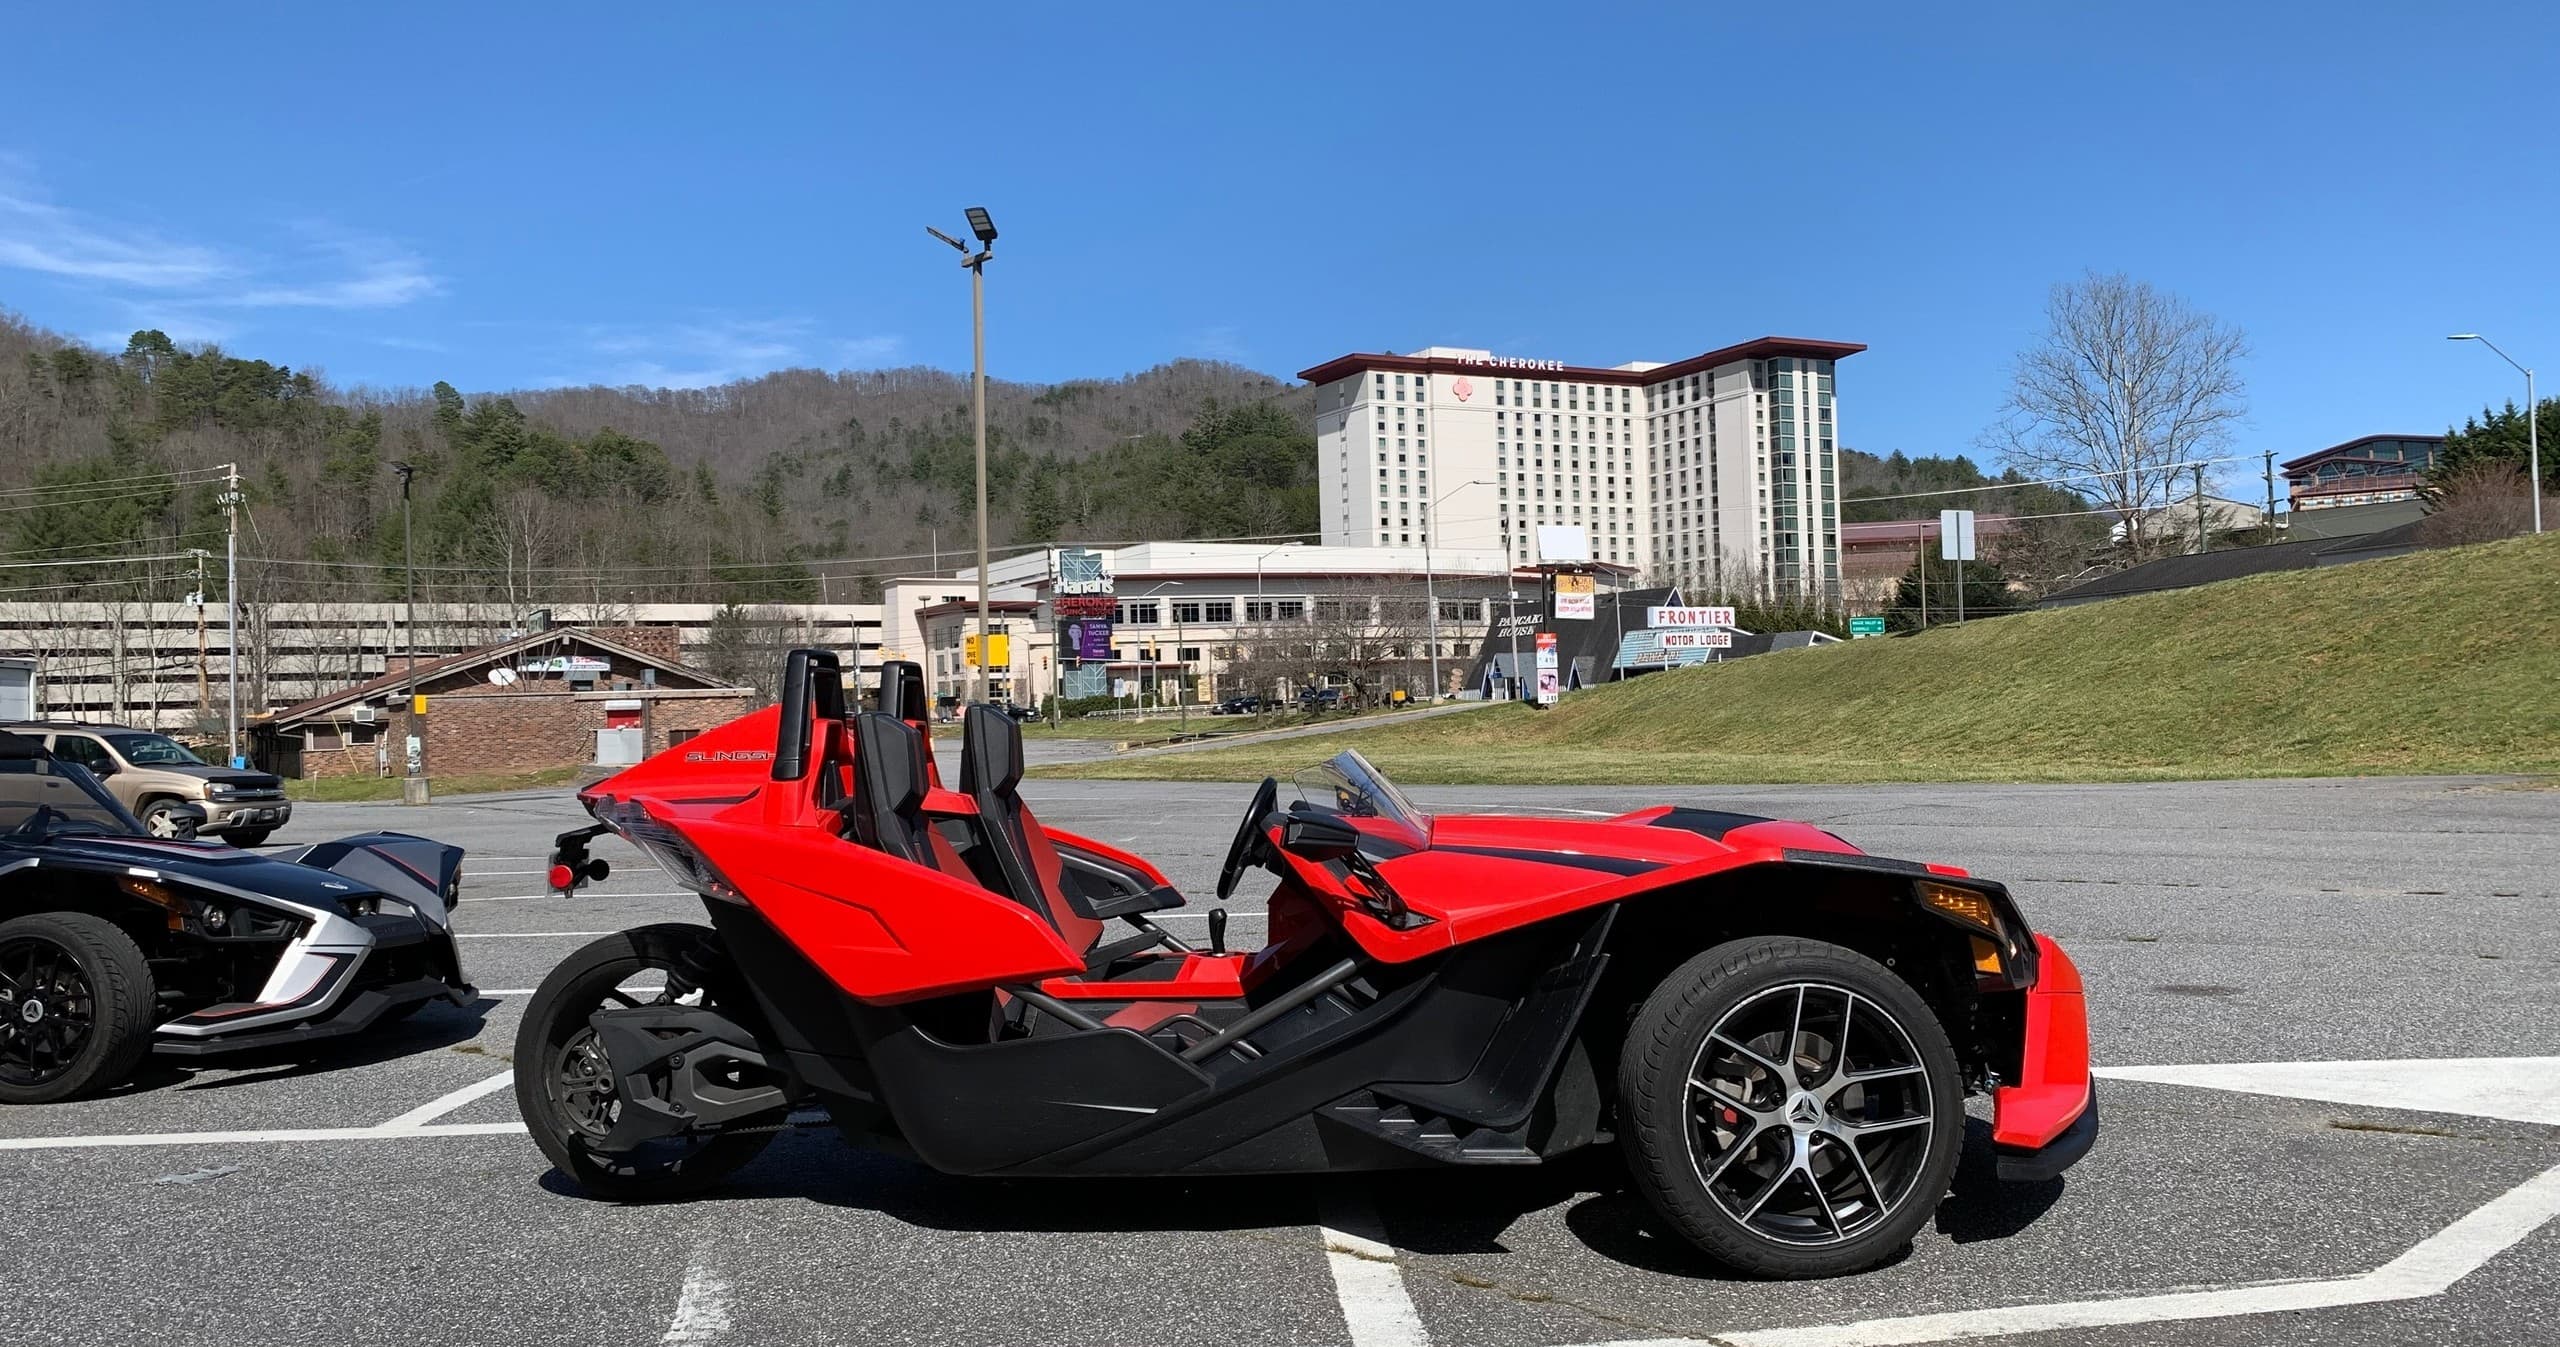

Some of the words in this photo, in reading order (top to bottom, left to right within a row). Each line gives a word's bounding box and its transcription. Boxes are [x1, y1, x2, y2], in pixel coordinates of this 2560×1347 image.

[1456, 354, 1483, 366] THE
[1489, 356, 1564, 371] CHEROKEE
[1658, 610, 1732, 624] FRONTIER
[1497, 625, 1536, 638] HOUSE
[1665, 635, 1694, 646] MOTOR
[1700, 635, 1729, 646] LODGE
[685, 751, 777, 762] SLINGSH
